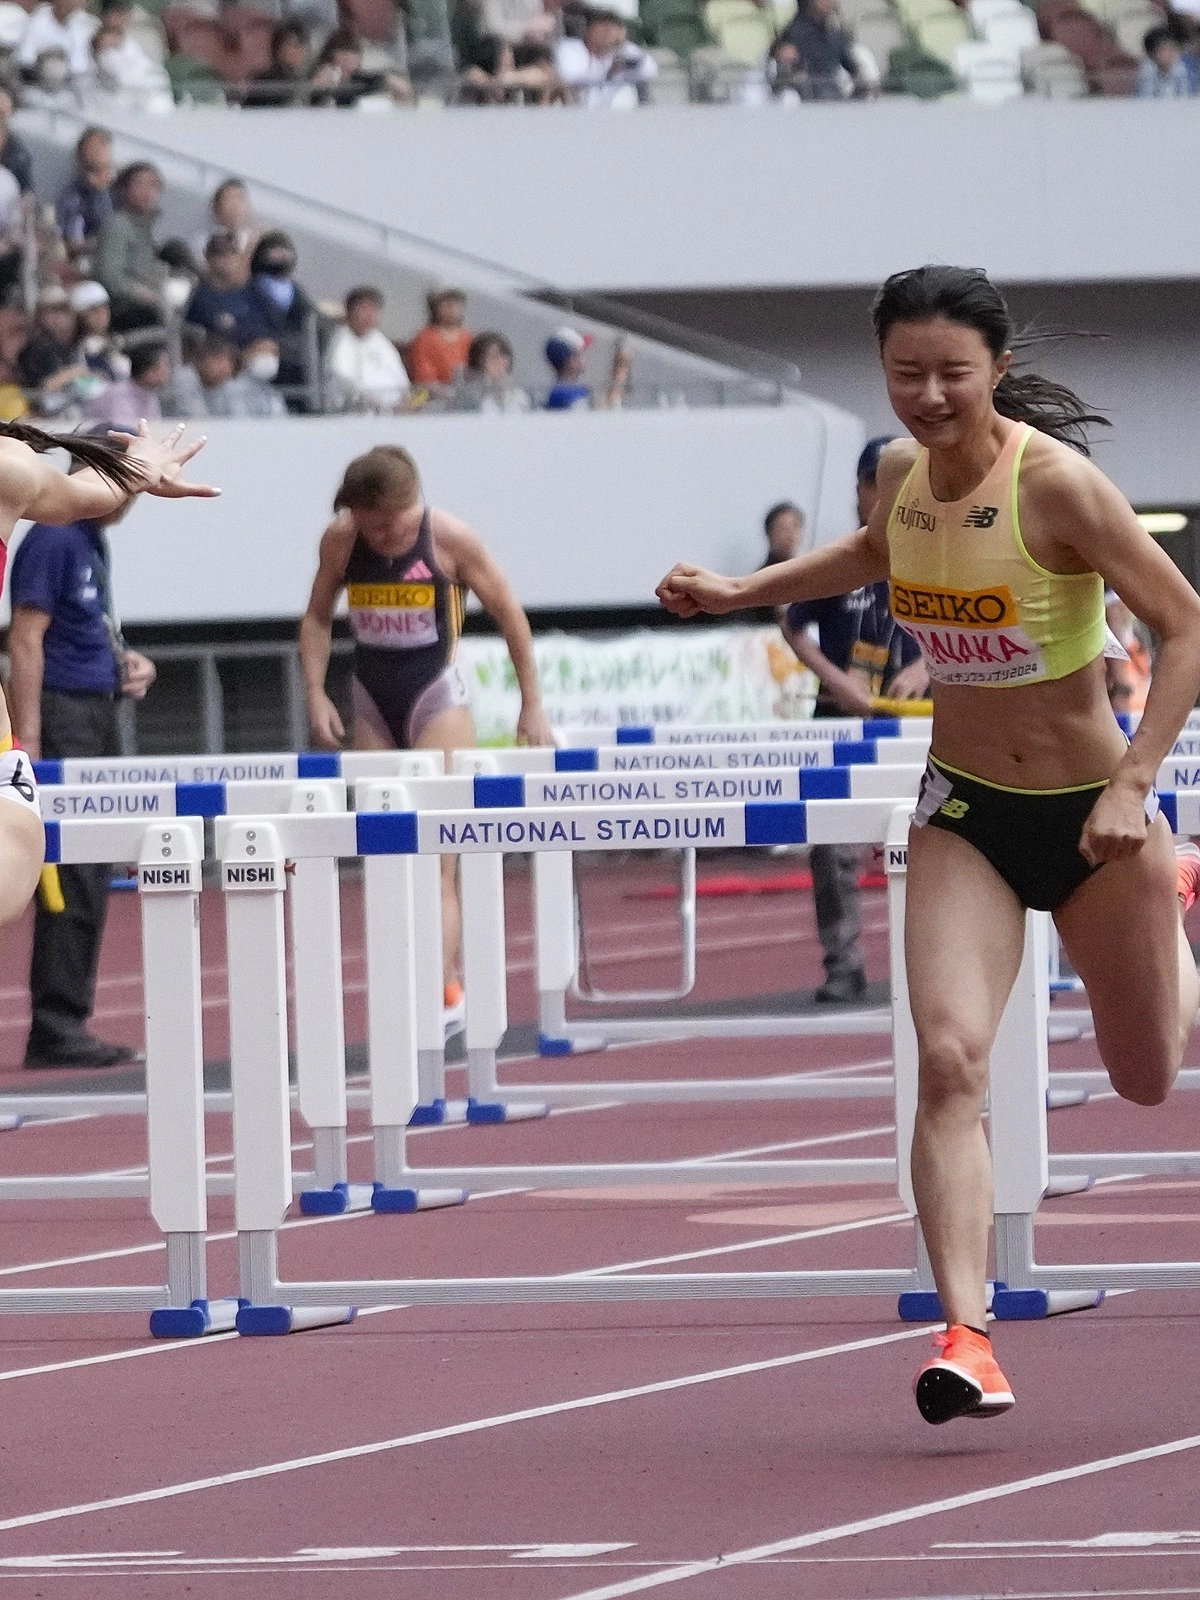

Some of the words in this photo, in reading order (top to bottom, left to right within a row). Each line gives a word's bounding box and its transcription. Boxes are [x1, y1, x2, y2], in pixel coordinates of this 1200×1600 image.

[897, 506, 937, 532] FUJITSU
[894, 585, 1007, 624] SEIKO
[614, 754, 718, 771] NATIONAL
[727, 751, 820, 769] STADIUM
[80, 767, 179, 784] NATIONAL
[193, 764, 285, 782] STADIUM
[543, 782, 665, 802] NATIONAL
[675, 779, 783, 799] STADIUM
[53, 794, 160, 815] STADIUM
[439, 820, 586, 844] NATIONAL
[597, 816, 725, 841] STADIUM
[143, 869, 190, 885] NISHI
[227, 867, 275, 883] NISHI
